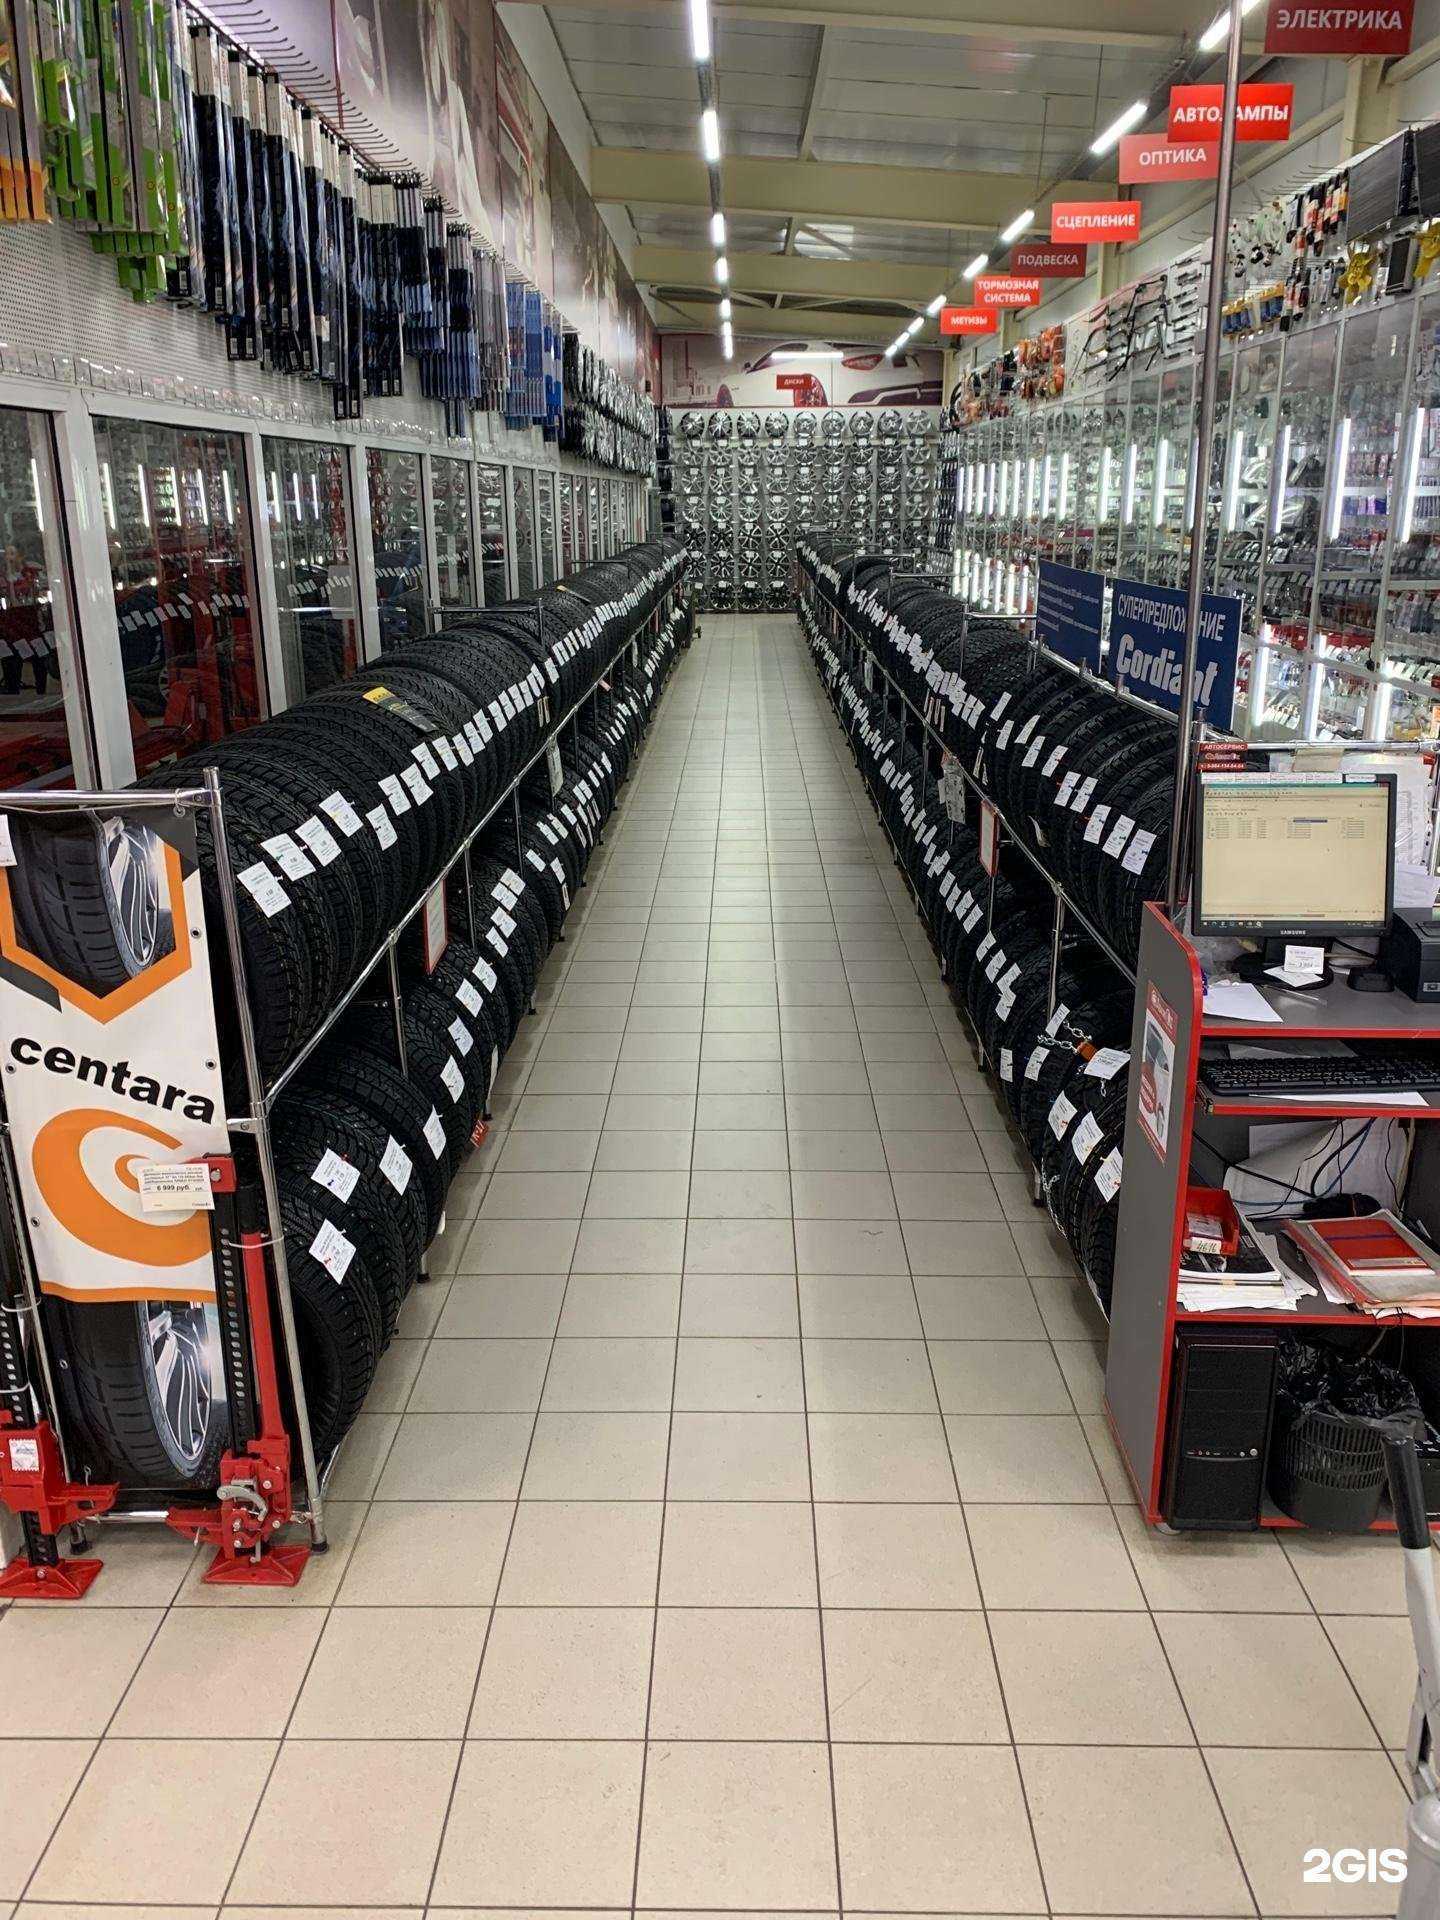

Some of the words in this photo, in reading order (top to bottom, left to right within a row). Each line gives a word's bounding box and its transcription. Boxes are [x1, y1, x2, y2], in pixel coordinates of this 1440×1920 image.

[1276, 9, 1403, 30] ЭЛЕКТРИКА
[1173, 105, 1288, 123] АВТОАМПЫ
[1138, 148, 1207, 166] ОПТИКА
[1056, 213, 1136, 230] СЦЕПЛЕНИЕ
[1017, 255, 1079, 266] ПОДВЕСКА
[977, 280, 1040, 291] ТОРМОЗНАЯ
[984, 293, 1032, 304] СИСТЕМА
[950, 316, 988, 326] МЕТИЗЫ
[1117, 593, 1226, 642] СУПЕРПРЕДЛОЖНИЕ
[10, 1037, 215, 1125] centara
